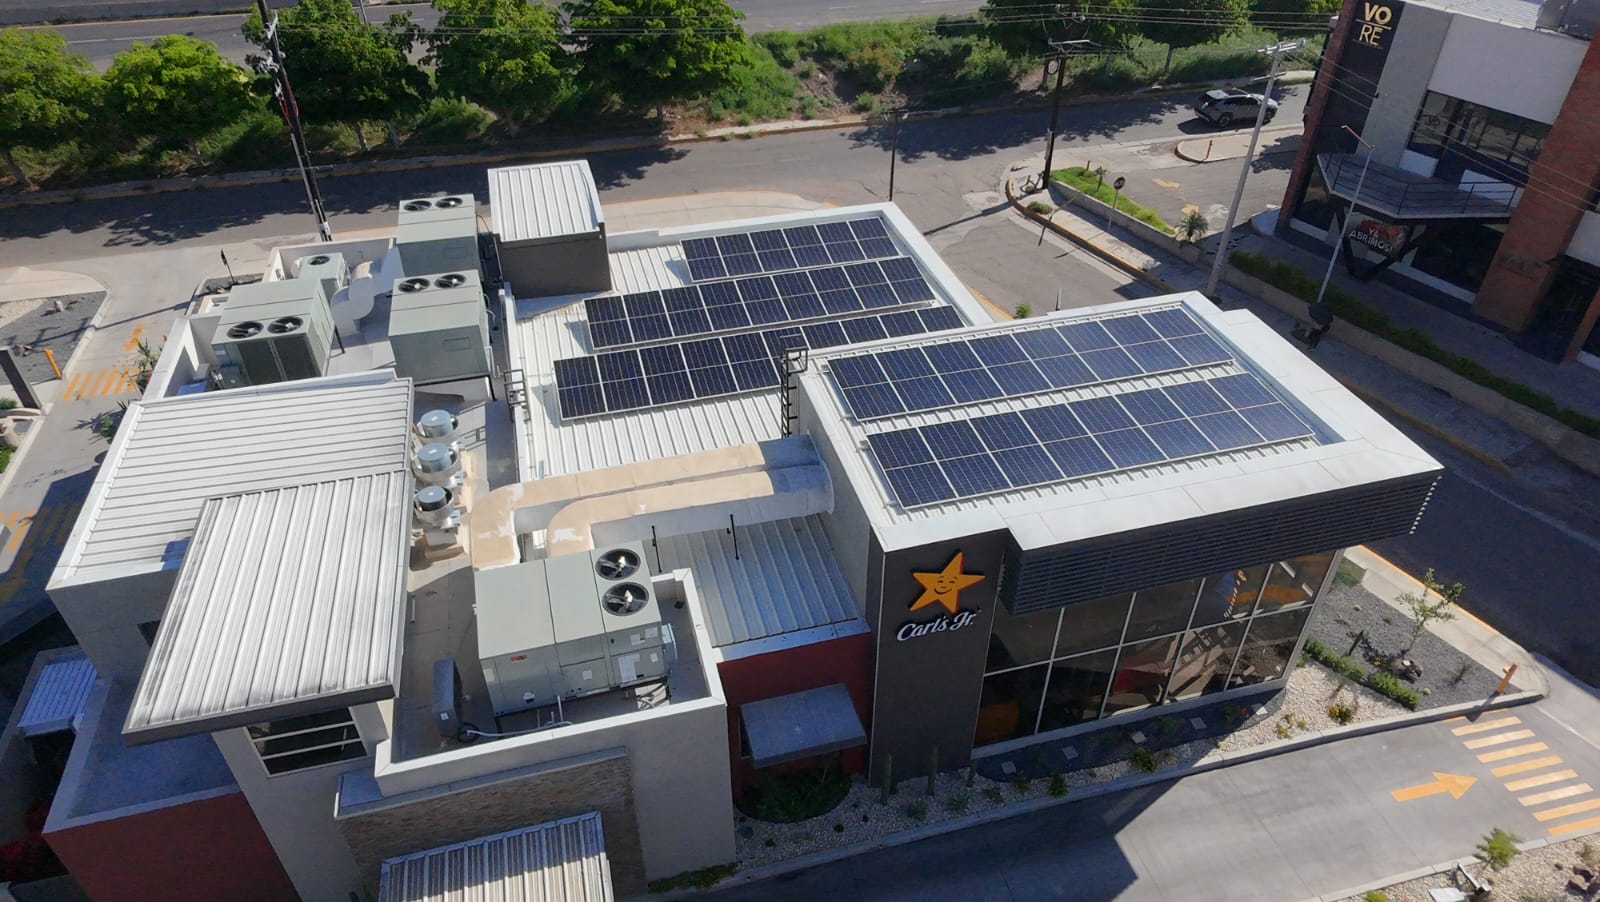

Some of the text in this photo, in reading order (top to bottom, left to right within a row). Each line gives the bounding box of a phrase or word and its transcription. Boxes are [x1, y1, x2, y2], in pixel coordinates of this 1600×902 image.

[1364, 2, 1392, 25] VO
[1359, 24, 1383, 46] RE
[1368, 227, 1379, 238] YA
[896, 611, 977, 641] Carl's Jr.
